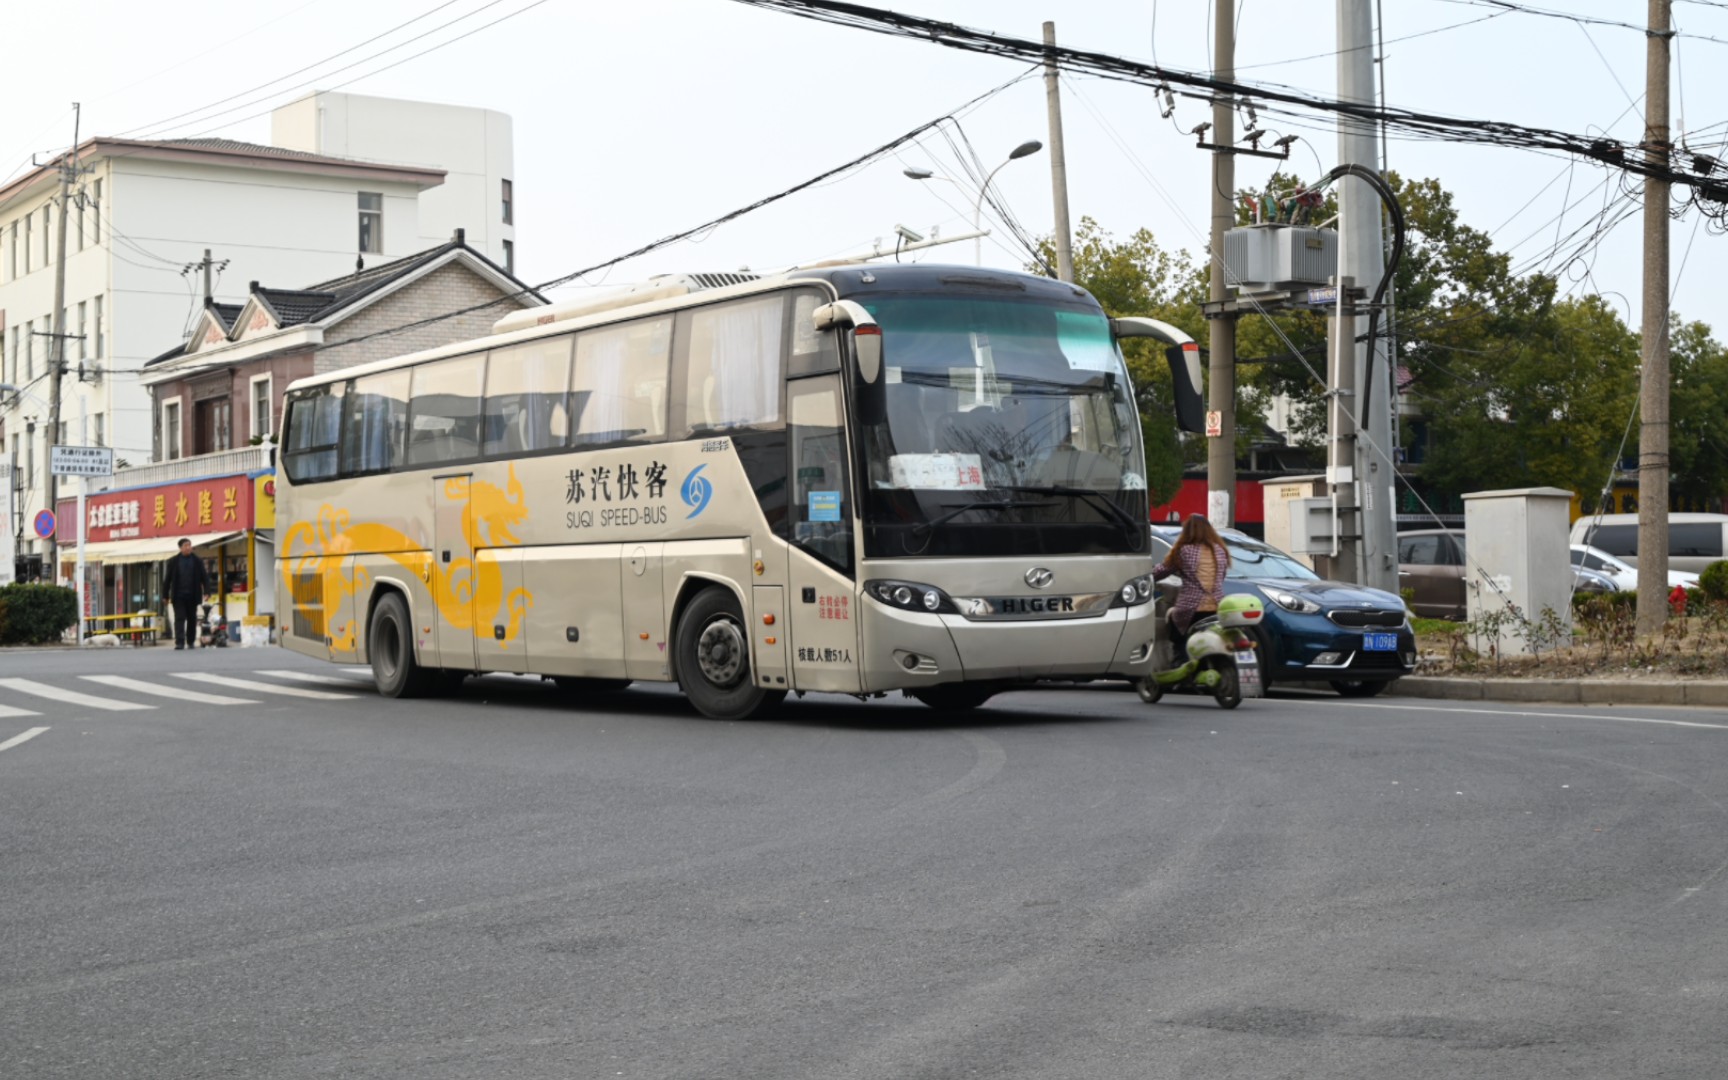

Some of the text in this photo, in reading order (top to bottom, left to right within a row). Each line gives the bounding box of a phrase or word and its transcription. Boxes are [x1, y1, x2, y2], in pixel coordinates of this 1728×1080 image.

[565, 461, 668, 504] 苏汽快客
[958, 465, 981, 485] 上海
[566, 505, 667, 529] SUQI SPEED-BUS
[1002, 597, 1074, 613] HIGER
[798, 647, 852, 663] 核载人数51人
